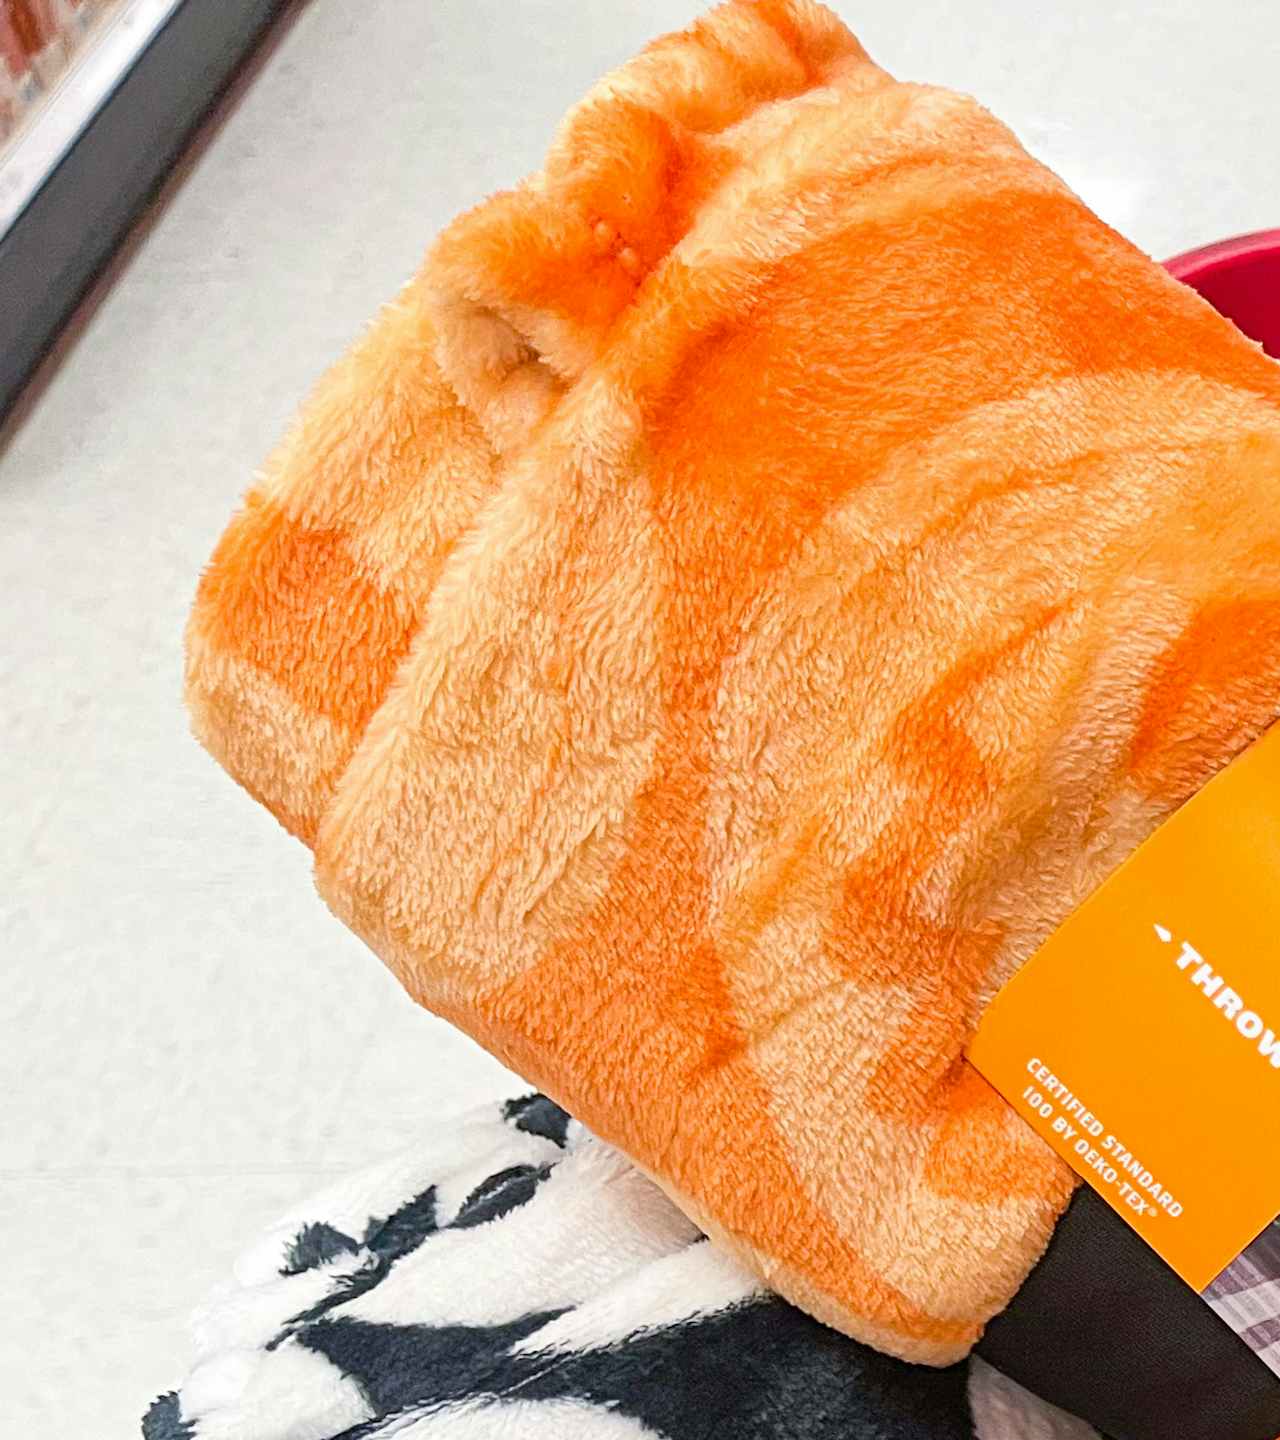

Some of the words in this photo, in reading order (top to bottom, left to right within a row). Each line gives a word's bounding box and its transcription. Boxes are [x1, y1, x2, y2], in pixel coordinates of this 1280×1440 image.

[1023, 1086, 1054, 1118] 100
[1052, 1116, 1077, 1140] BY
[1026, 1058, 1104, 1137] CERTIFIED
[1101, 1135, 1184, 1218] STANDARD
